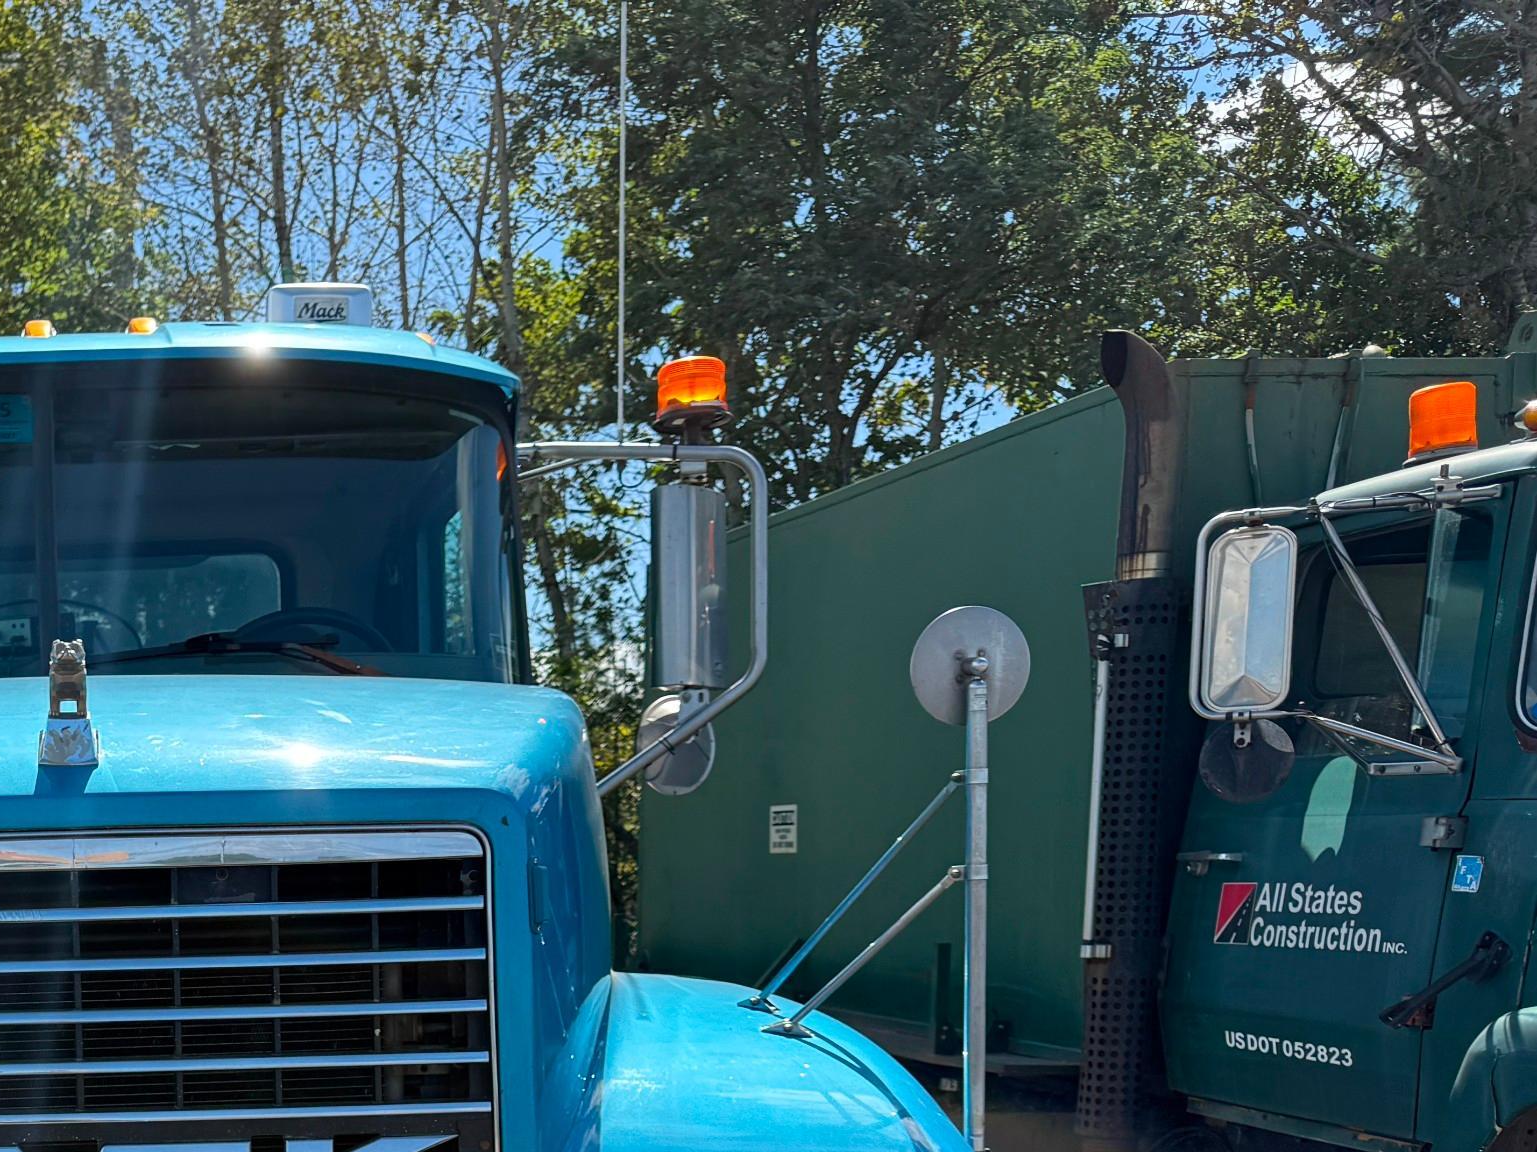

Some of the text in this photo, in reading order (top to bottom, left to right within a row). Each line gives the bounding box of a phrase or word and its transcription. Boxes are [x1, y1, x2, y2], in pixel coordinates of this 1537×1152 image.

[297, 302, 346, 322] Mack
[1254, 882, 1363, 914] All States
[1250, 917, 1408, 955] Construction INC.
[1282, 1039, 1353, 1067] 052823
